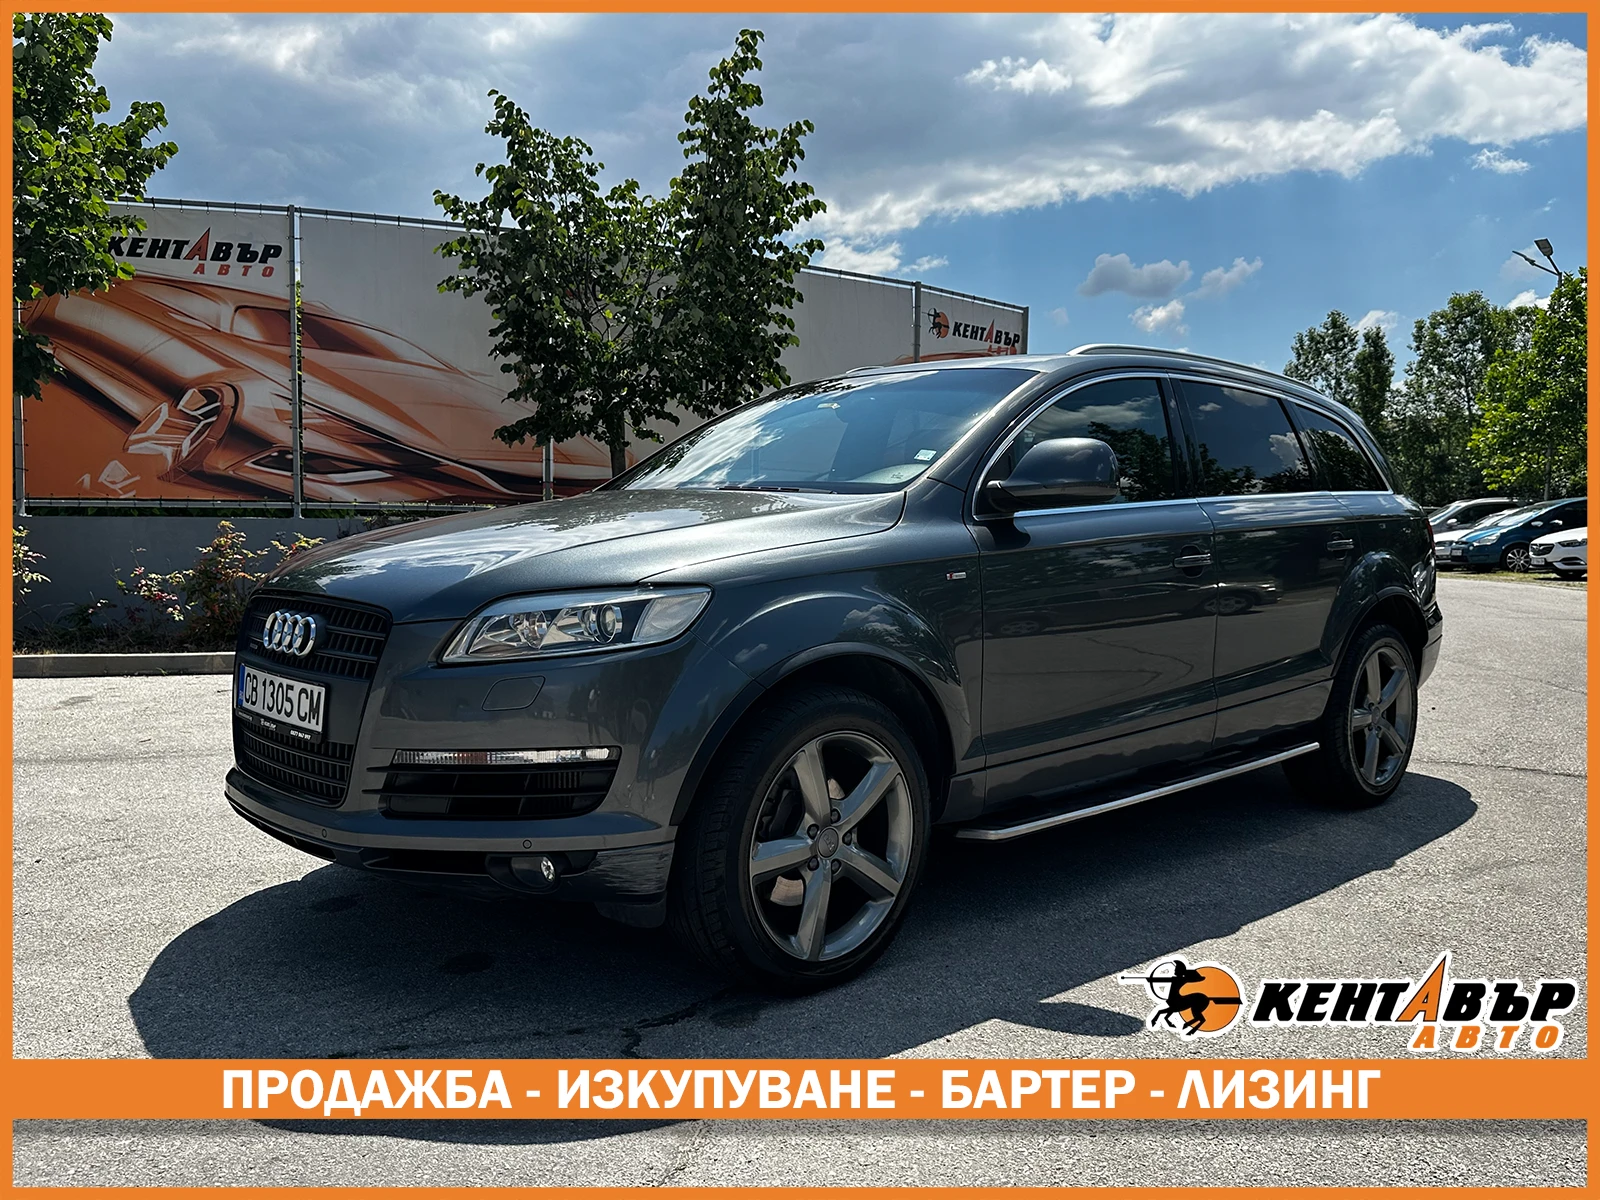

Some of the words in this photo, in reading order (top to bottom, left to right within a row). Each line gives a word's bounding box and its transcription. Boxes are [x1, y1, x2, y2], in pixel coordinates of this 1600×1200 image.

[109, 227, 282, 264] КЕНТАВЪР
[193, 263, 275, 278] АВТО
[952, 319, 1020, 347] КЕНТАВЪР
[244, 672, 258, 706] CB
[262, 678, 294, 718] 1305
[297, 687, 321, 726] CM
